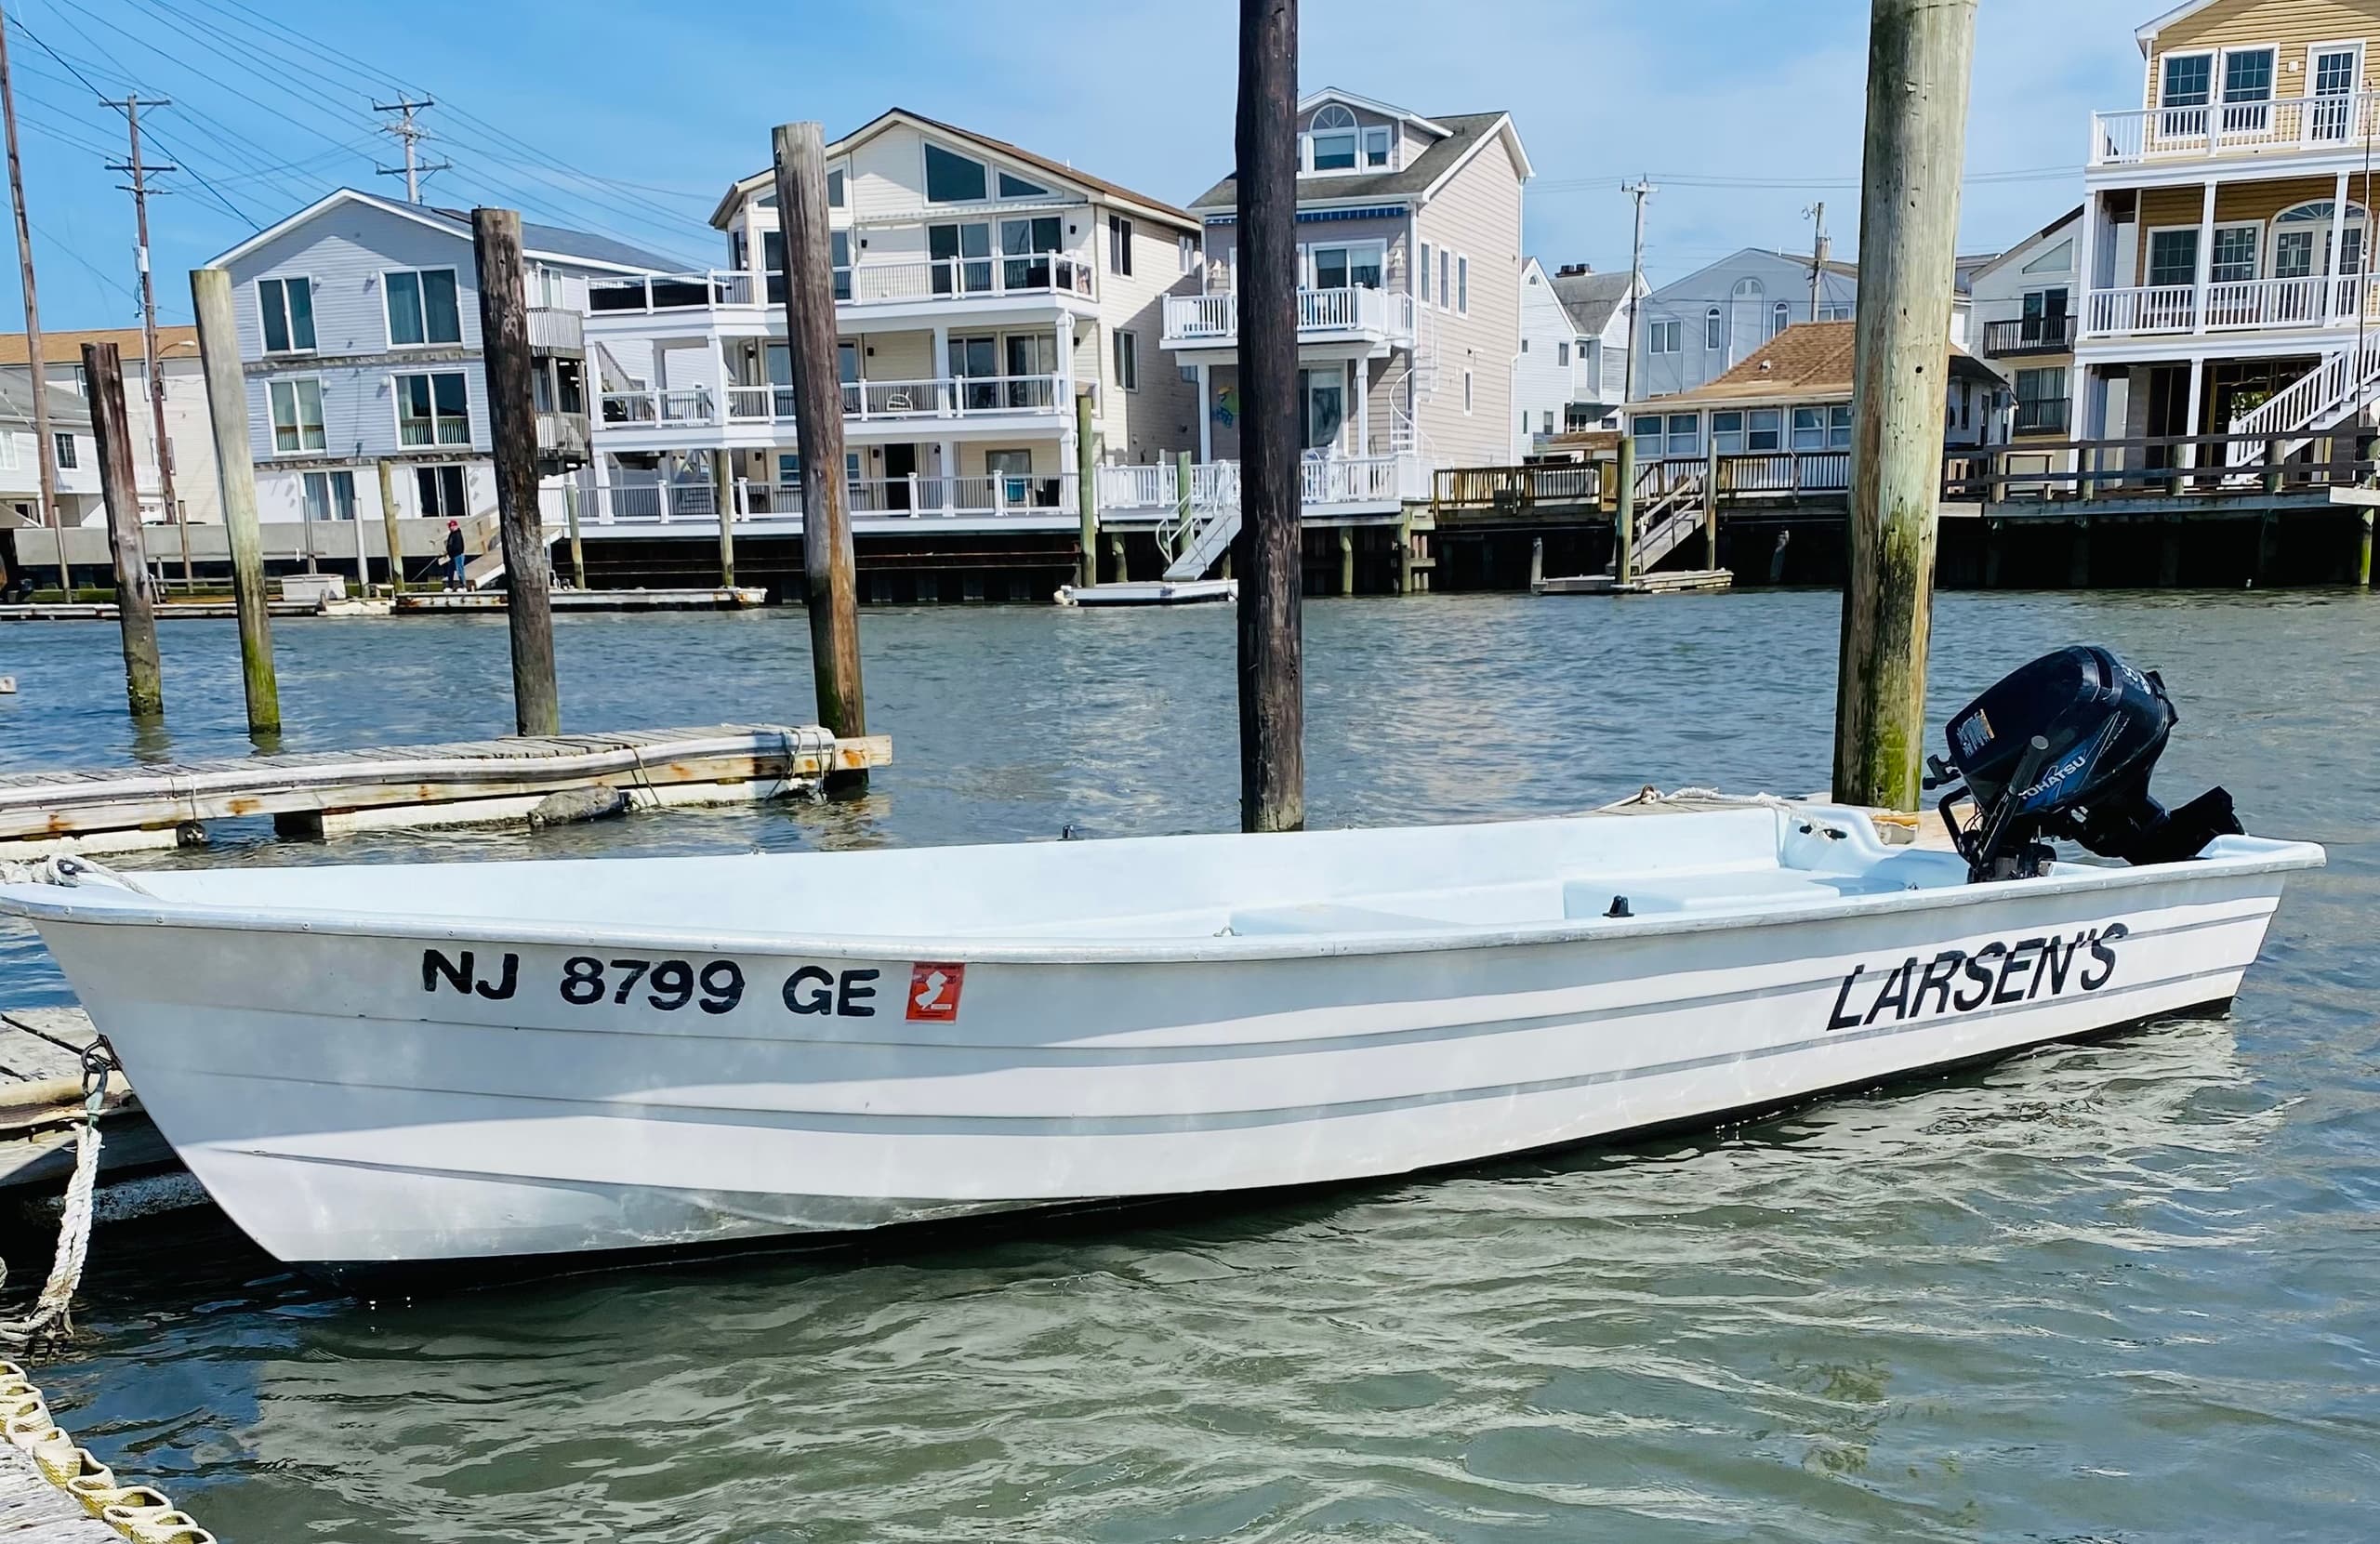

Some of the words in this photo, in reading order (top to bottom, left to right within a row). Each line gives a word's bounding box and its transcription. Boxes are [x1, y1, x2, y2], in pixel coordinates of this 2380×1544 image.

[422, 948, 520, 1000] NJ
[560, 956, 746, 1015] 8799
[782, 965, 880, 1017] GE
[1826, 922, 2129, 1031] LARSEN'S
